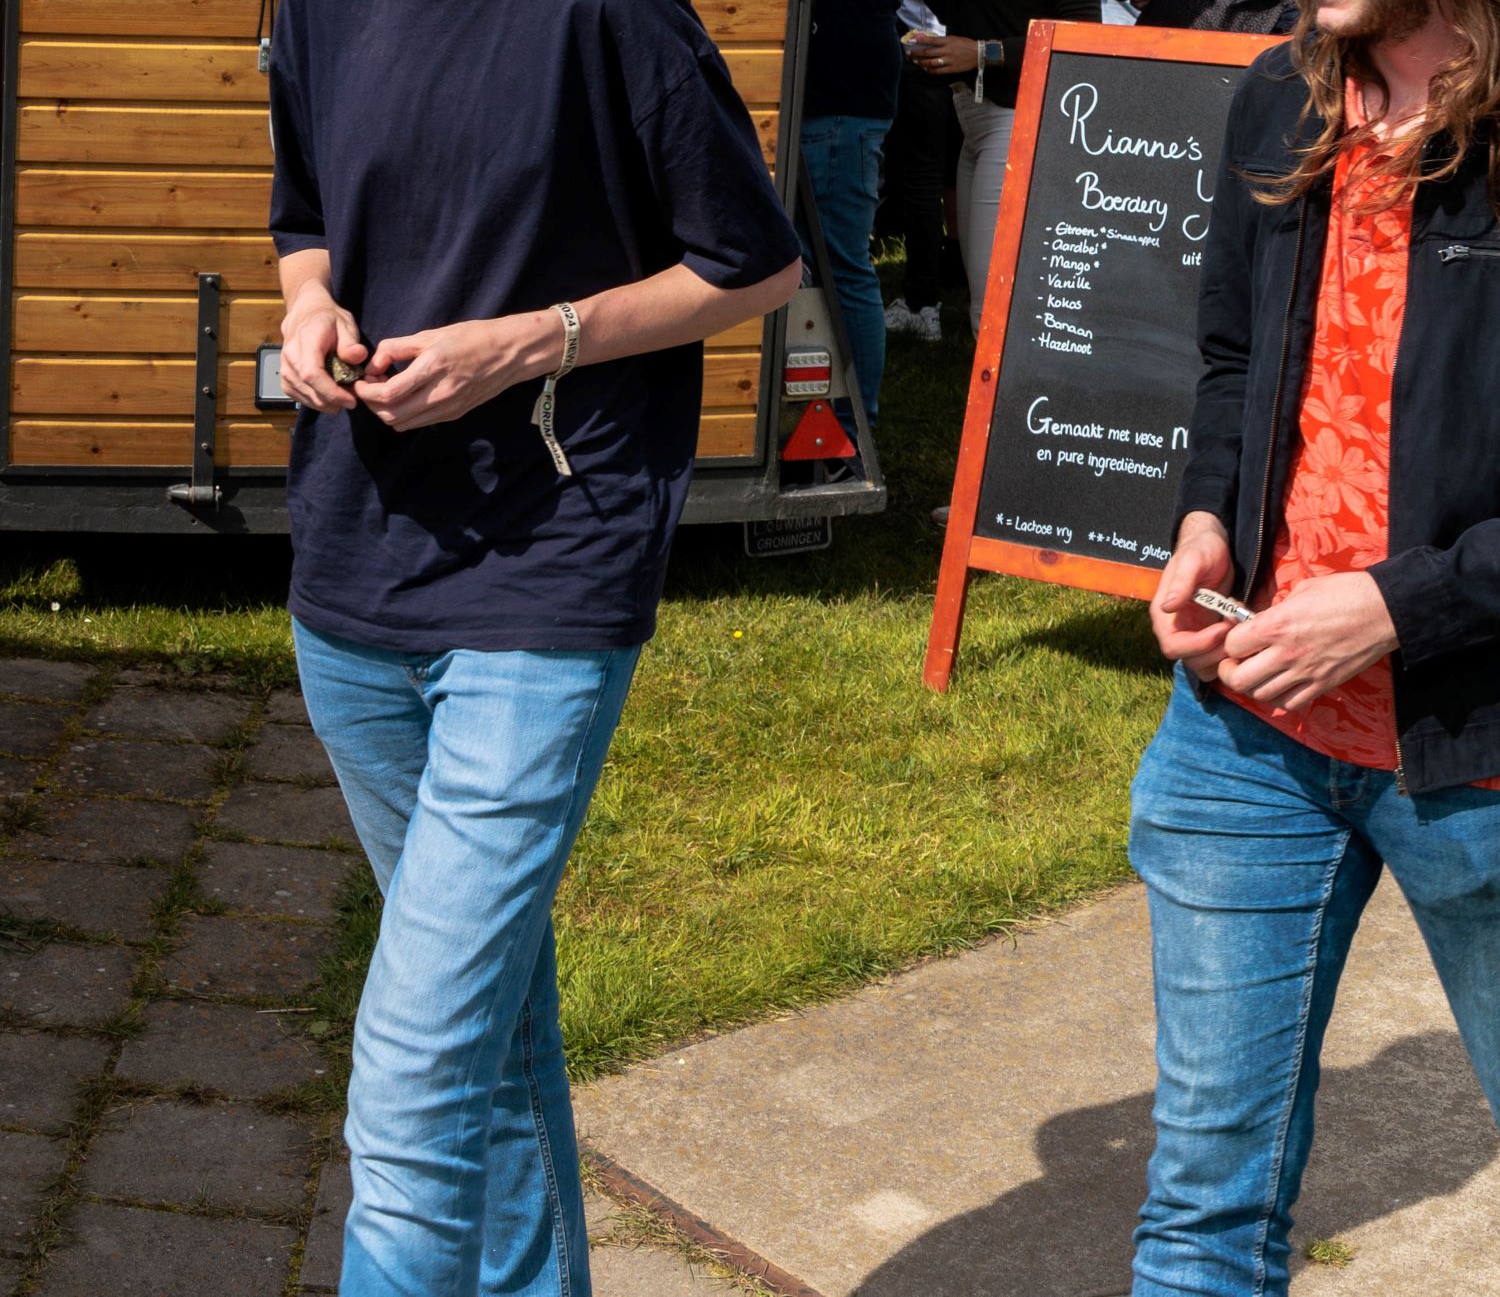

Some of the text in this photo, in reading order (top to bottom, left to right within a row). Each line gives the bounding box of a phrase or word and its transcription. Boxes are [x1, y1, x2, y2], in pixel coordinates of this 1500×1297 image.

[1060, 82, 1203, 161] Rianne's
[1075, 171, 1168, 232] Boerdery
[1049, 254, 1091, 276] Mango
[1048, 273, 1092, 290] Vanille
[1046, 293, 1083, 311] Kokos
[1043, 312, 1093, 340] Banaan
[566, 337, 578, 364] NEW
[1038, 332, 1093, 355] Hazelnoot
[541, 394, 553, 438] FORUM
[1026, 396, 1105, 439] Gemaakt
[1107, 426, 1131, 442] met
[1134, 430, 1164, 449] verse
[1036, 448, 1052, 461] en
[1056, 449, 1085, 467] pure
[1014, 515, 1053, 536] Lactose
[1056, 526, 1073, 545] vry
[1111, 531, 1138, 552] bevat
